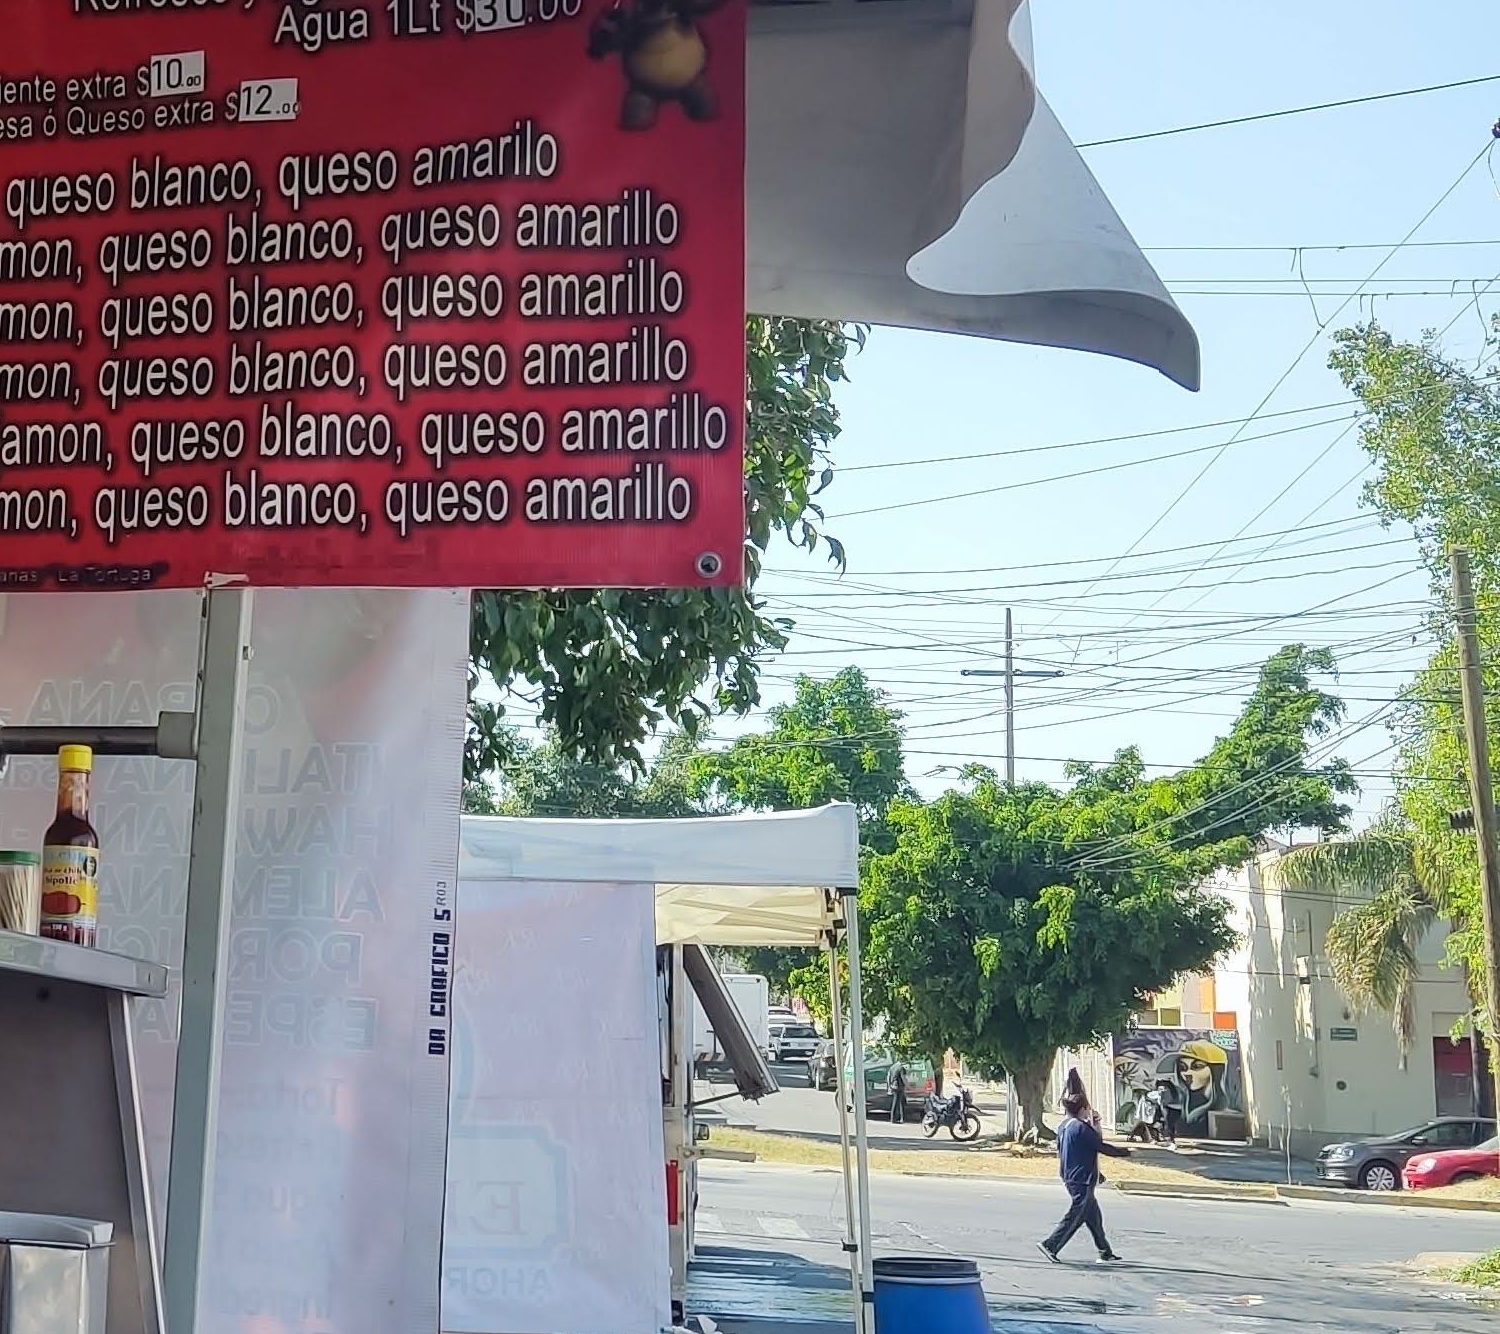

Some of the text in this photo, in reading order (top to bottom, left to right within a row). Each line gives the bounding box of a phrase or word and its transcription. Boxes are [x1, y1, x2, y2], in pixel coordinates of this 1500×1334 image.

[274, 2, 368, 52] Agua
[67, 73, 126, 100] extra
[67, 106, 145, 136] Queso
[155, 99, 213, 128] extra
[6, 173, 114, 231] queso
[130, 156, 262, 209] blanco,
[279, 150, 397, 209] queso
[413, 121, 557, 185] amarilo
[99, 226, 211, 291] queso
[227, 212, 363, 266] blanco,
[381, 204, 500, 266] queso
[516, 190, 678, 246] amarillo
[100, 291, 212, 356] queso
[228, 277, 364, 332] blanco,
[382, 270, 502, 330] queso
[519, 259, 683, 316] amarillo
[99, 355, 213, 409] queso
[228, 345, 365, 395] blanco,
[384, 339, 506, 400] queso
[522, 327, 688, 383] amarillo
[131, 418, 244, 475] queso
[259, 403, 403, 463] blanco,
[421, 412, 544, 468] queso
[561, 394, 727, 453] amarillo
[95, 483, 208, 543] queso
[224, 471, 368, 532] blanco,
[385, 478, 508, 536] queso
[525, 464, 691, 523] amarillo
